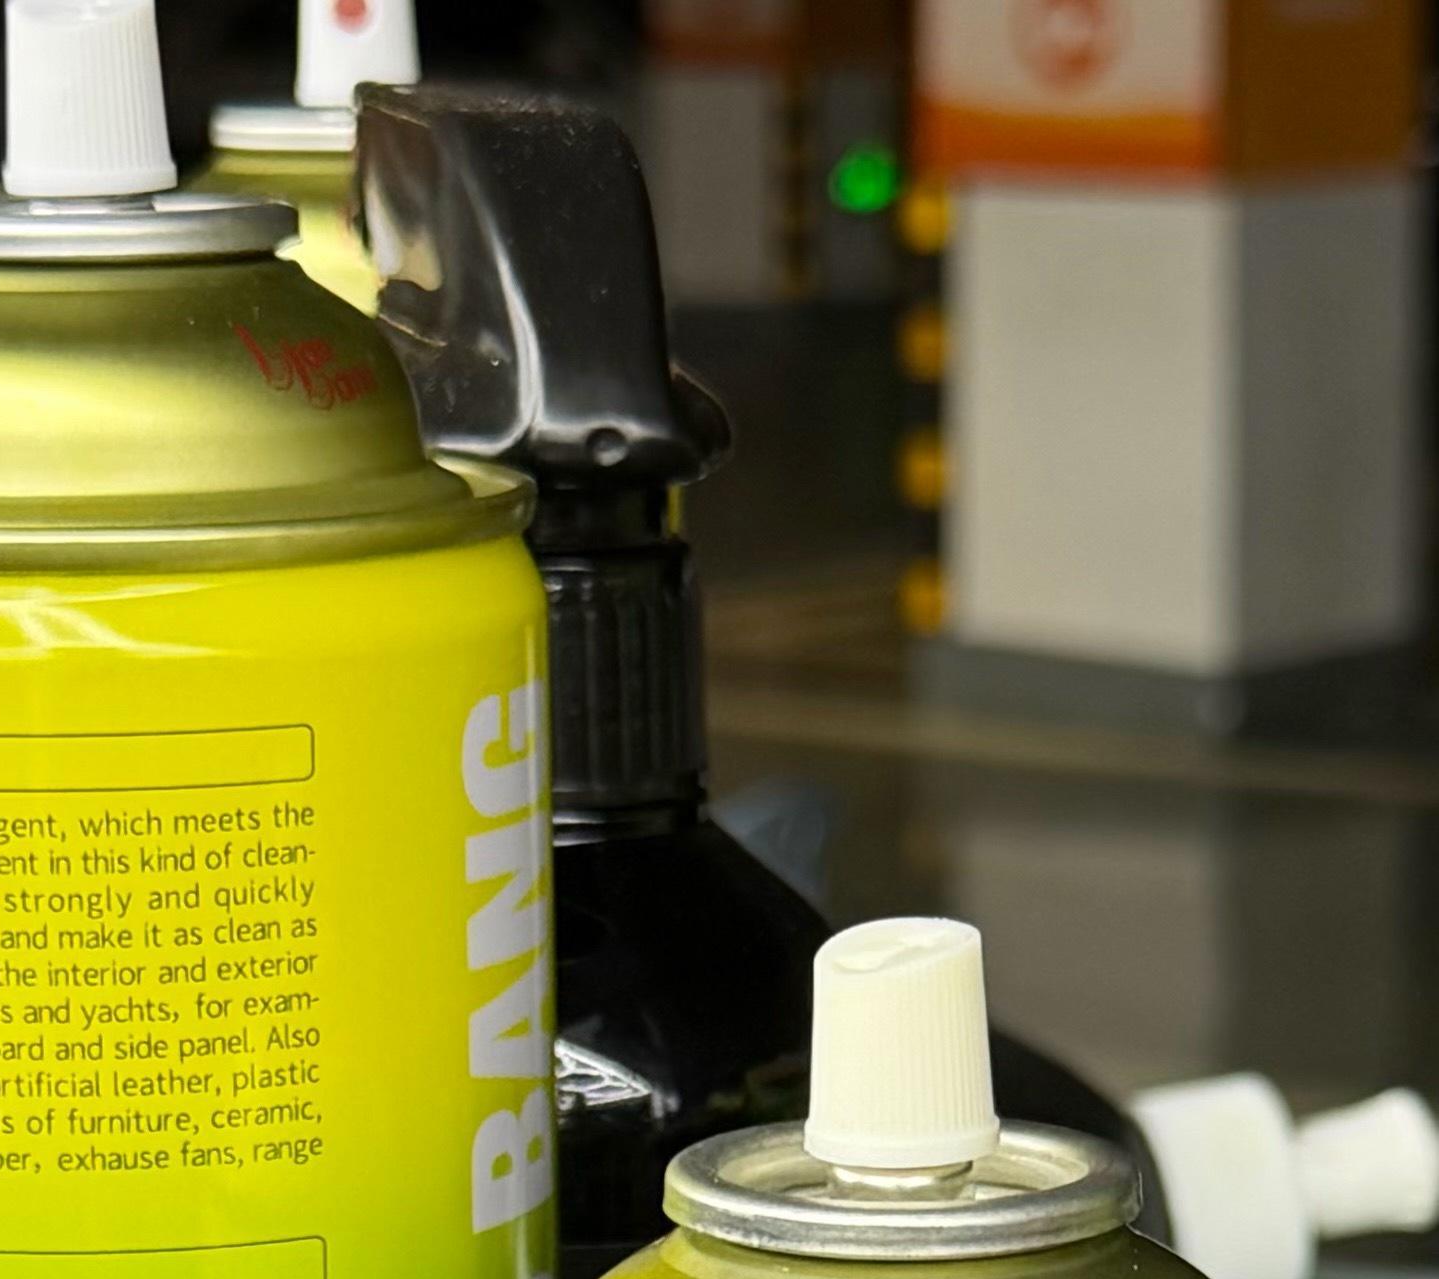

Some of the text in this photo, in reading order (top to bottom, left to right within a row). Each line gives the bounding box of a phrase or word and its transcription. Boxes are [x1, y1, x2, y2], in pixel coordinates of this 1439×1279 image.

[79, 810, 161, 837] which
[174, 809, 260, 834] meets
[274, 802, 314, 828] the
[50, 850, 71, 875] in
[82, 849, 130, 875] this
[140, 845, 195, 872] kind
[205, 842, 232, 870] of
[243, 841, 315, 867] clean-
[5, 885, 132, 919] strongly
[148, 883, 199, 910] and
[214, 876, 314, 913] quickly
[461, 679, 553, 1235] BANG
[23, 998, 70, 1024] and
[81, 997, 179, 1030] yachts,
[196, 992, 232, 1019] for
[244, 992, 319, 1016] exam-
[58, 1146, 169, 1171] exhause
[181, 1141, 243, 1168] fans,
[254, 1138, 322, 1164] range
